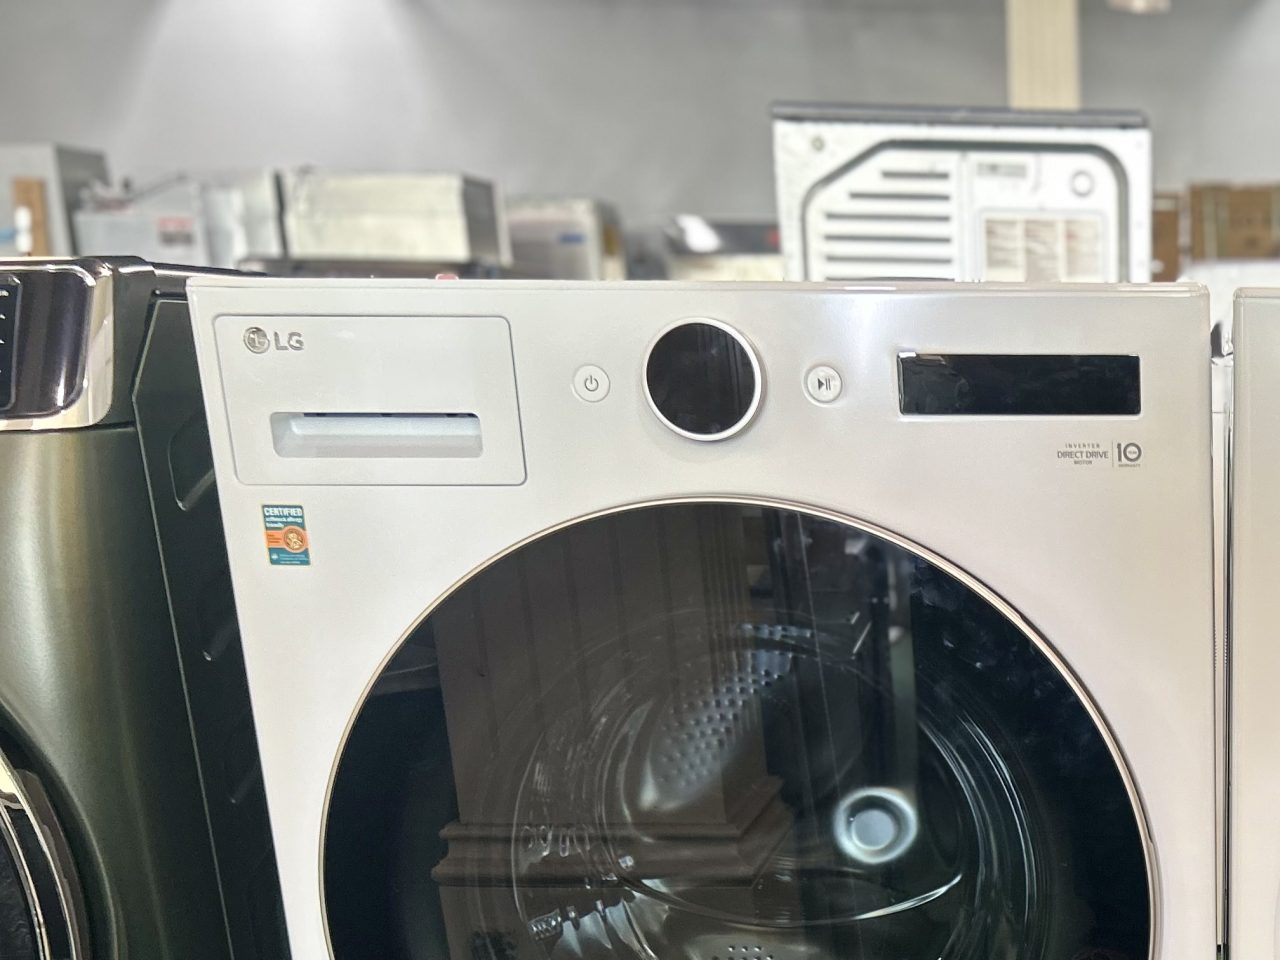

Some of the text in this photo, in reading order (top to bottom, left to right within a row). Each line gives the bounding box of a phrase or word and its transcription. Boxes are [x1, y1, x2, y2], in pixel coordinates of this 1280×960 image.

[273, 331, 305, 351] LG
[1057, 450, 1109, 459] DIRECT DRIVE
[1117, 442, 1142, 462] 10
[263, 507, 303, 516] CERTIFIED
